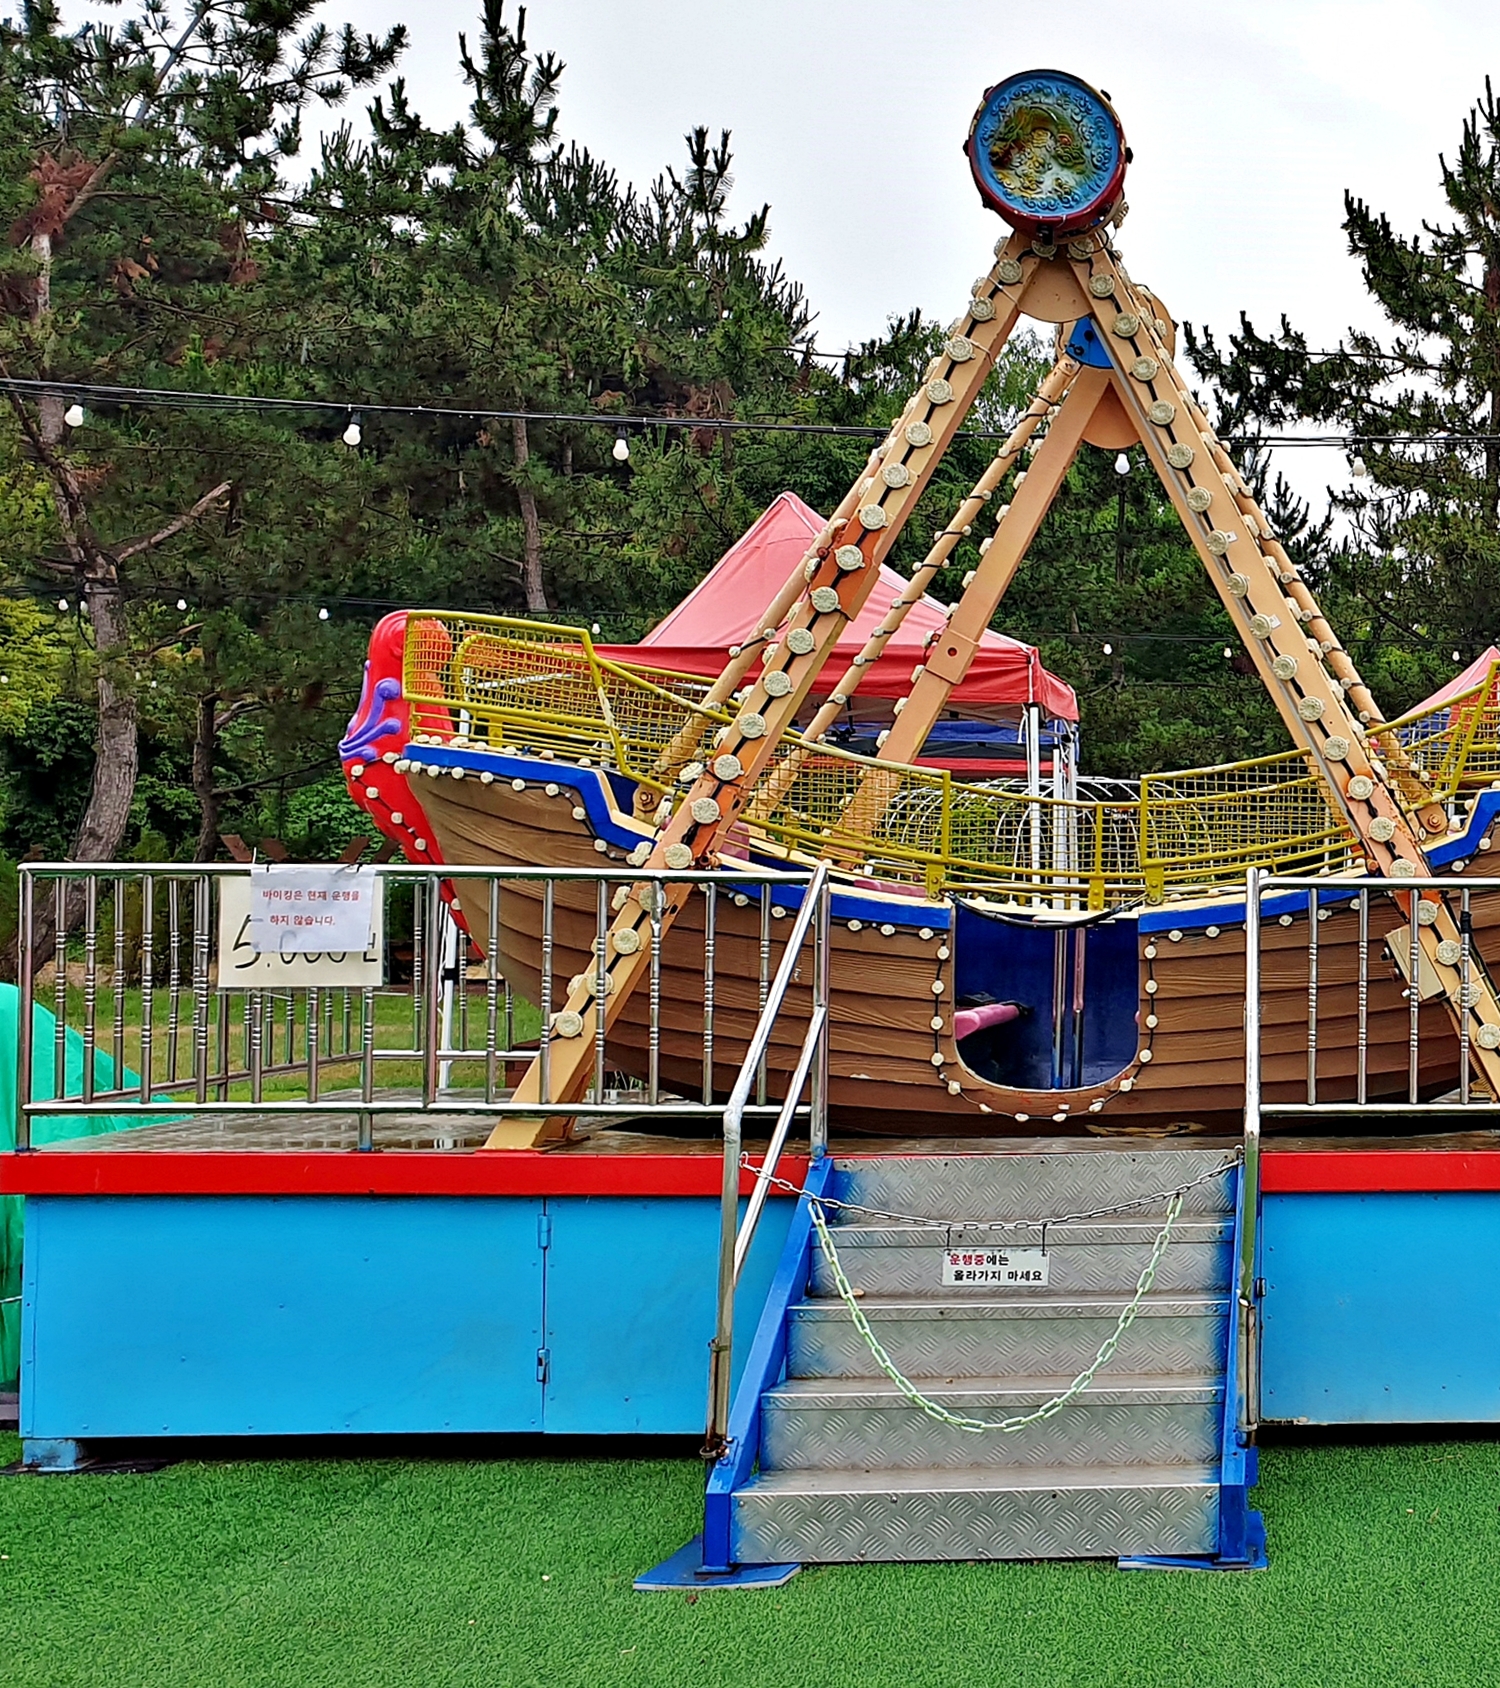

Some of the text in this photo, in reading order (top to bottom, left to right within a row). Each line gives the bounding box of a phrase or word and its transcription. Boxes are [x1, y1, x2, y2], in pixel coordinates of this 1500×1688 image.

[262, 889, 361, 901] 바이킹은 현재 운행을
[270, 914, 336, 926] 하지 않습니다.
[949, 1253, 1010, 1266] 운행중에는
[953, 1269, 1043, 1282] 올라가지 마세요
